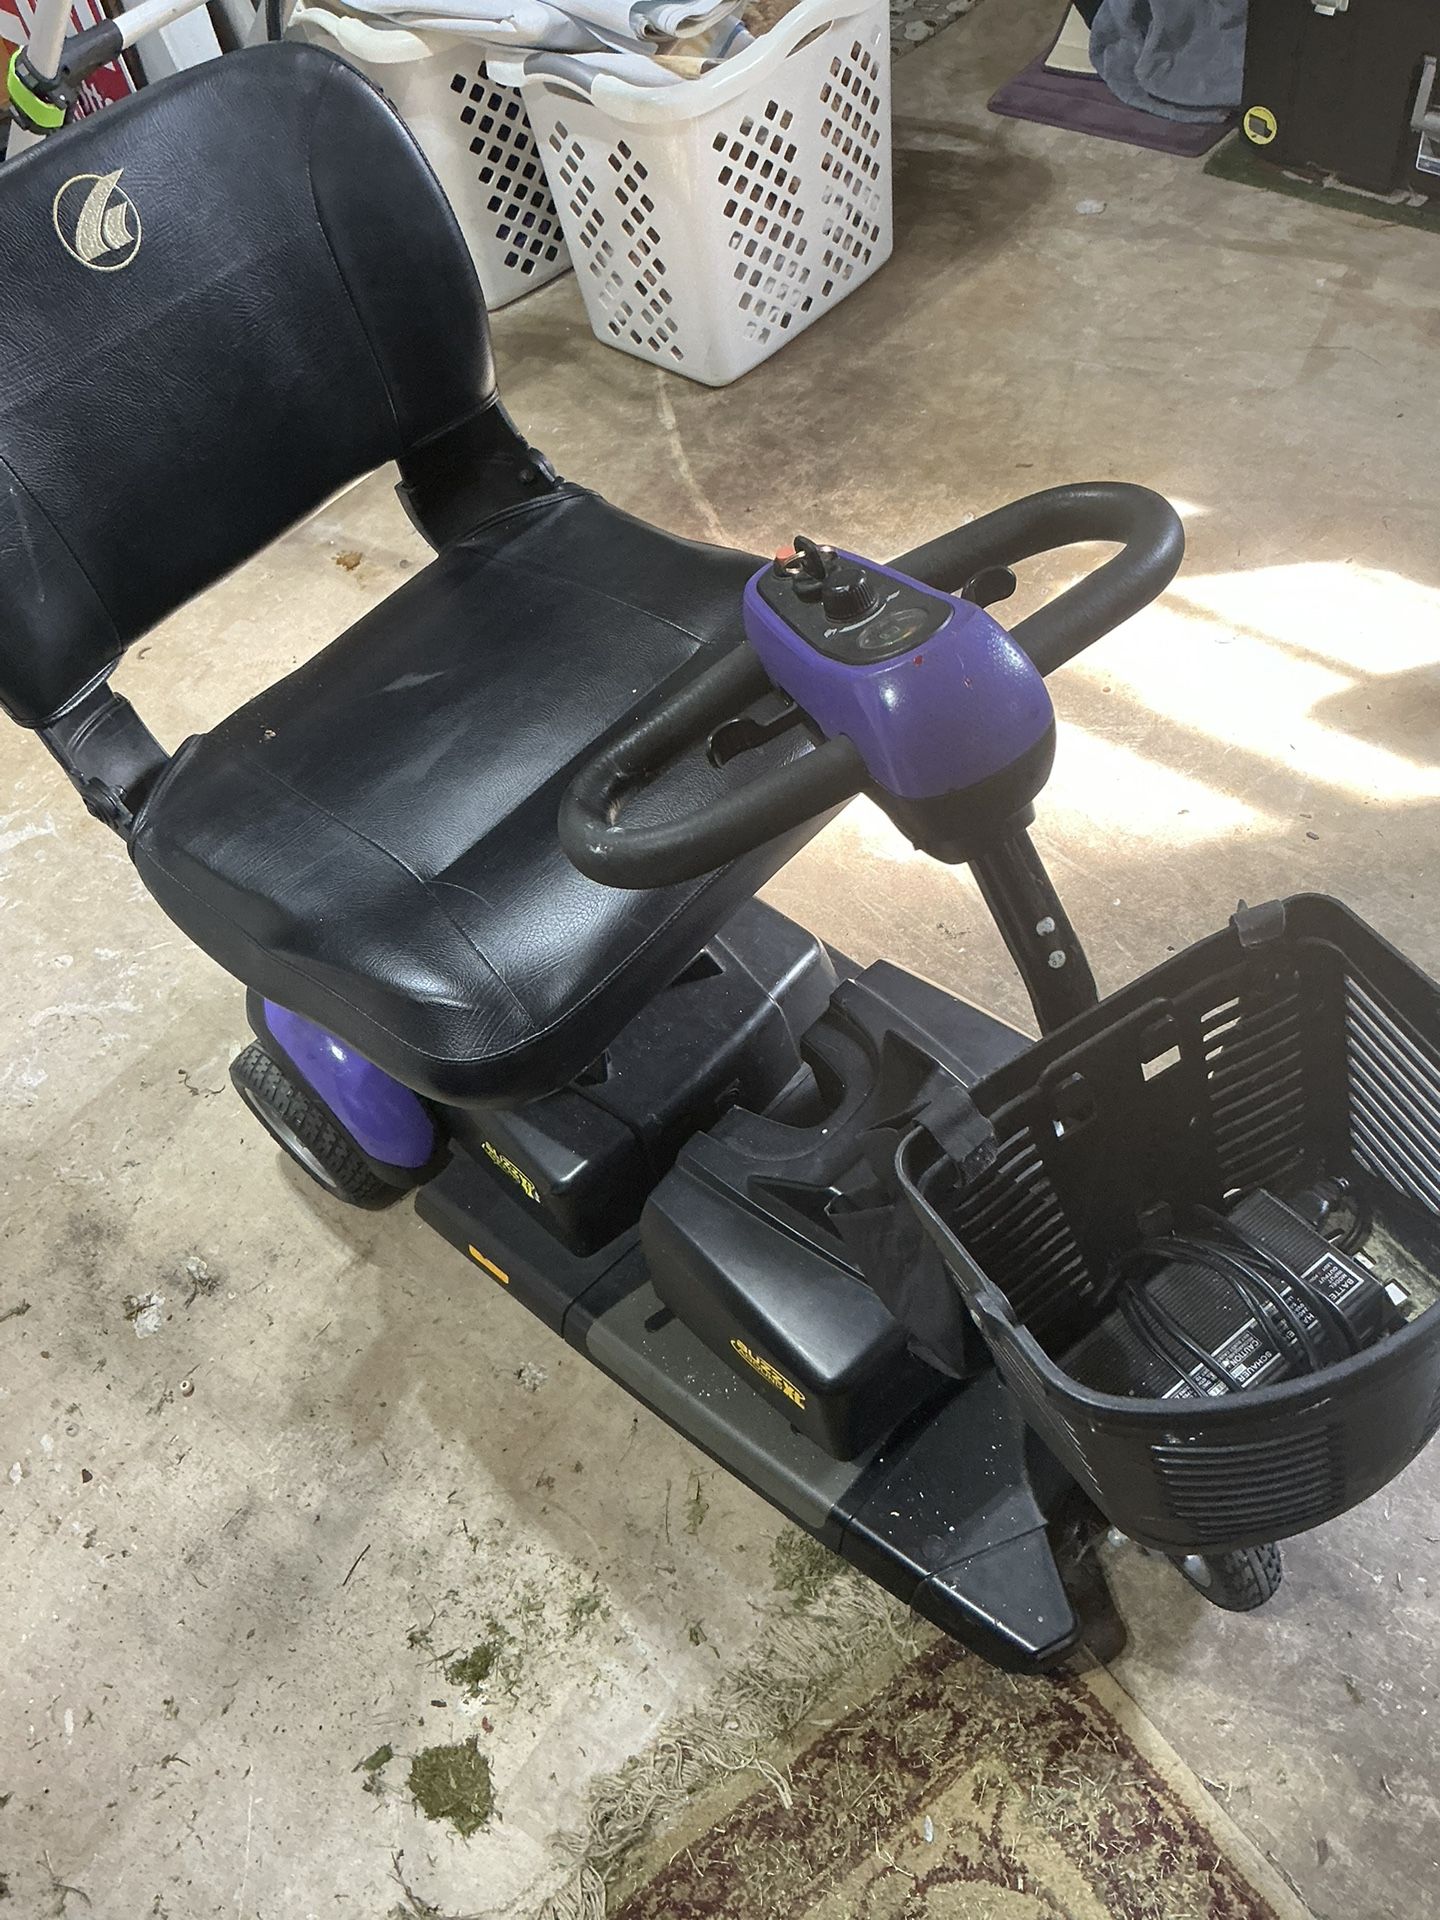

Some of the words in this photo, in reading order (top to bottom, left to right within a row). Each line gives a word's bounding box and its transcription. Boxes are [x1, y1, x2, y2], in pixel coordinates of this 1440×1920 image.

[1317, 1265, 1338, 1284] OUTPUT
[1327, 1269, 1342, 1283] INPUT
[1328, 1272, 1347, 1289] MODEL
[1327, 1277, 1354, 1301] BATTE
[1229, 1339, 1259, 1365] CAUTION
[1236, 1350, 1272, 1382] SCHAUER
